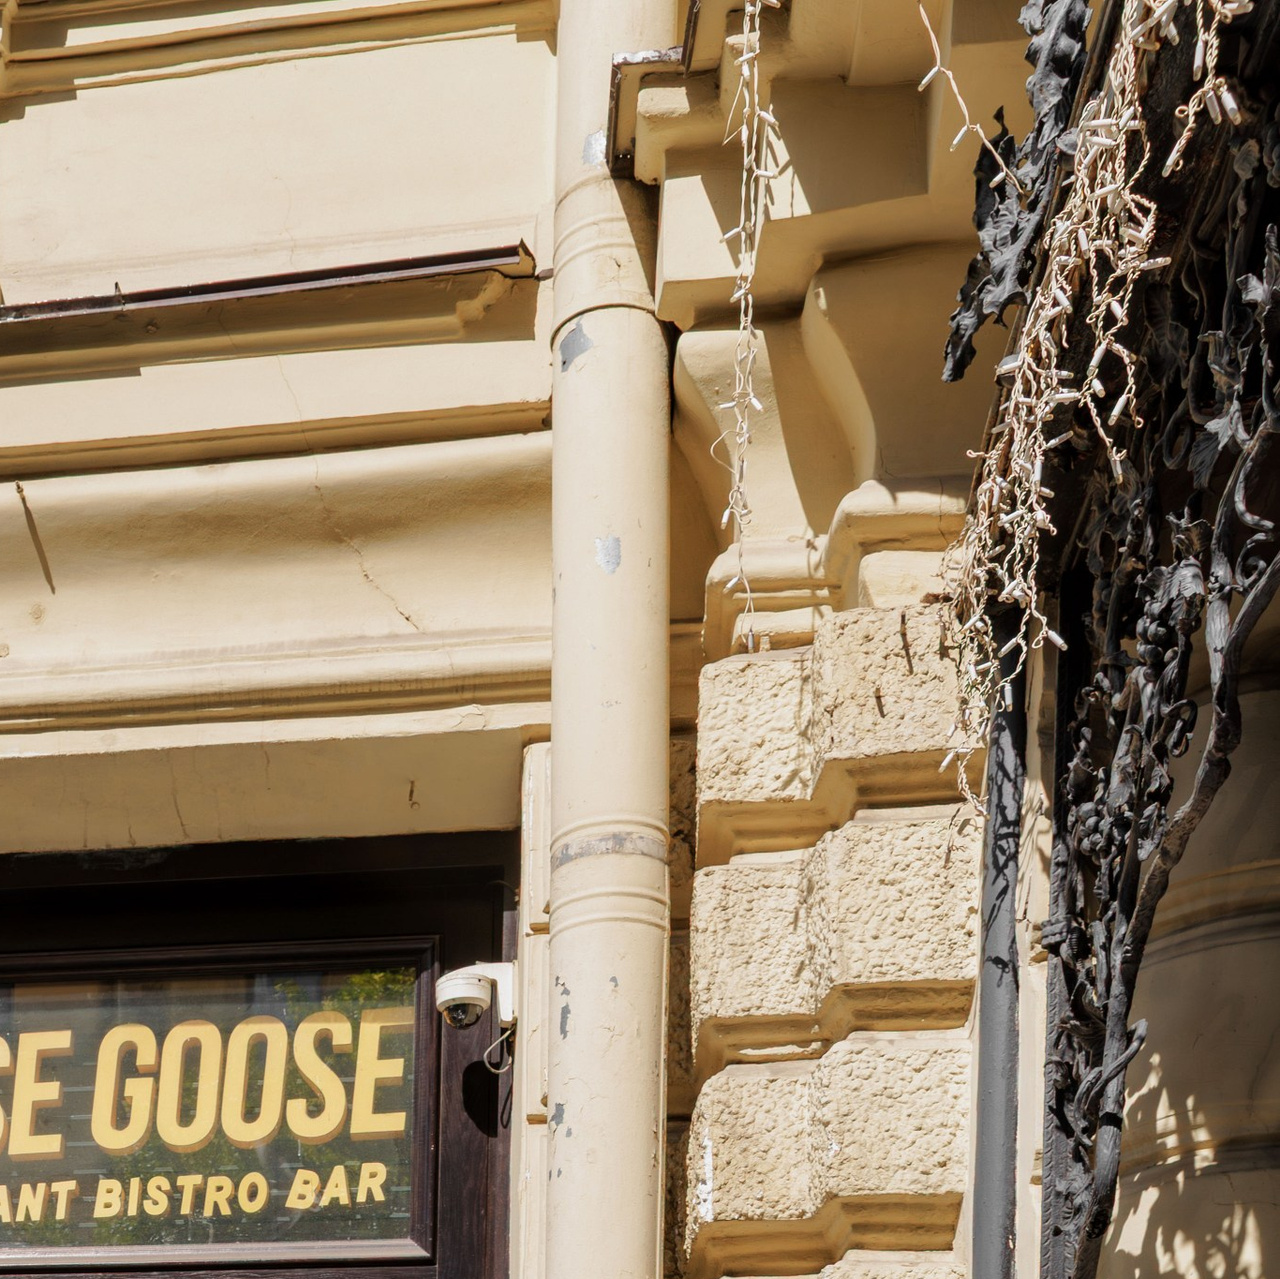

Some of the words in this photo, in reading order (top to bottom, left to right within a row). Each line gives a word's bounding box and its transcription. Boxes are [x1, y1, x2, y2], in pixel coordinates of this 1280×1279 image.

[90, 1006, 414, 1155] GOOSE
[93, 1171, 270, 1220] BISTRO
[284, 1161, 388, 1210] BAR
